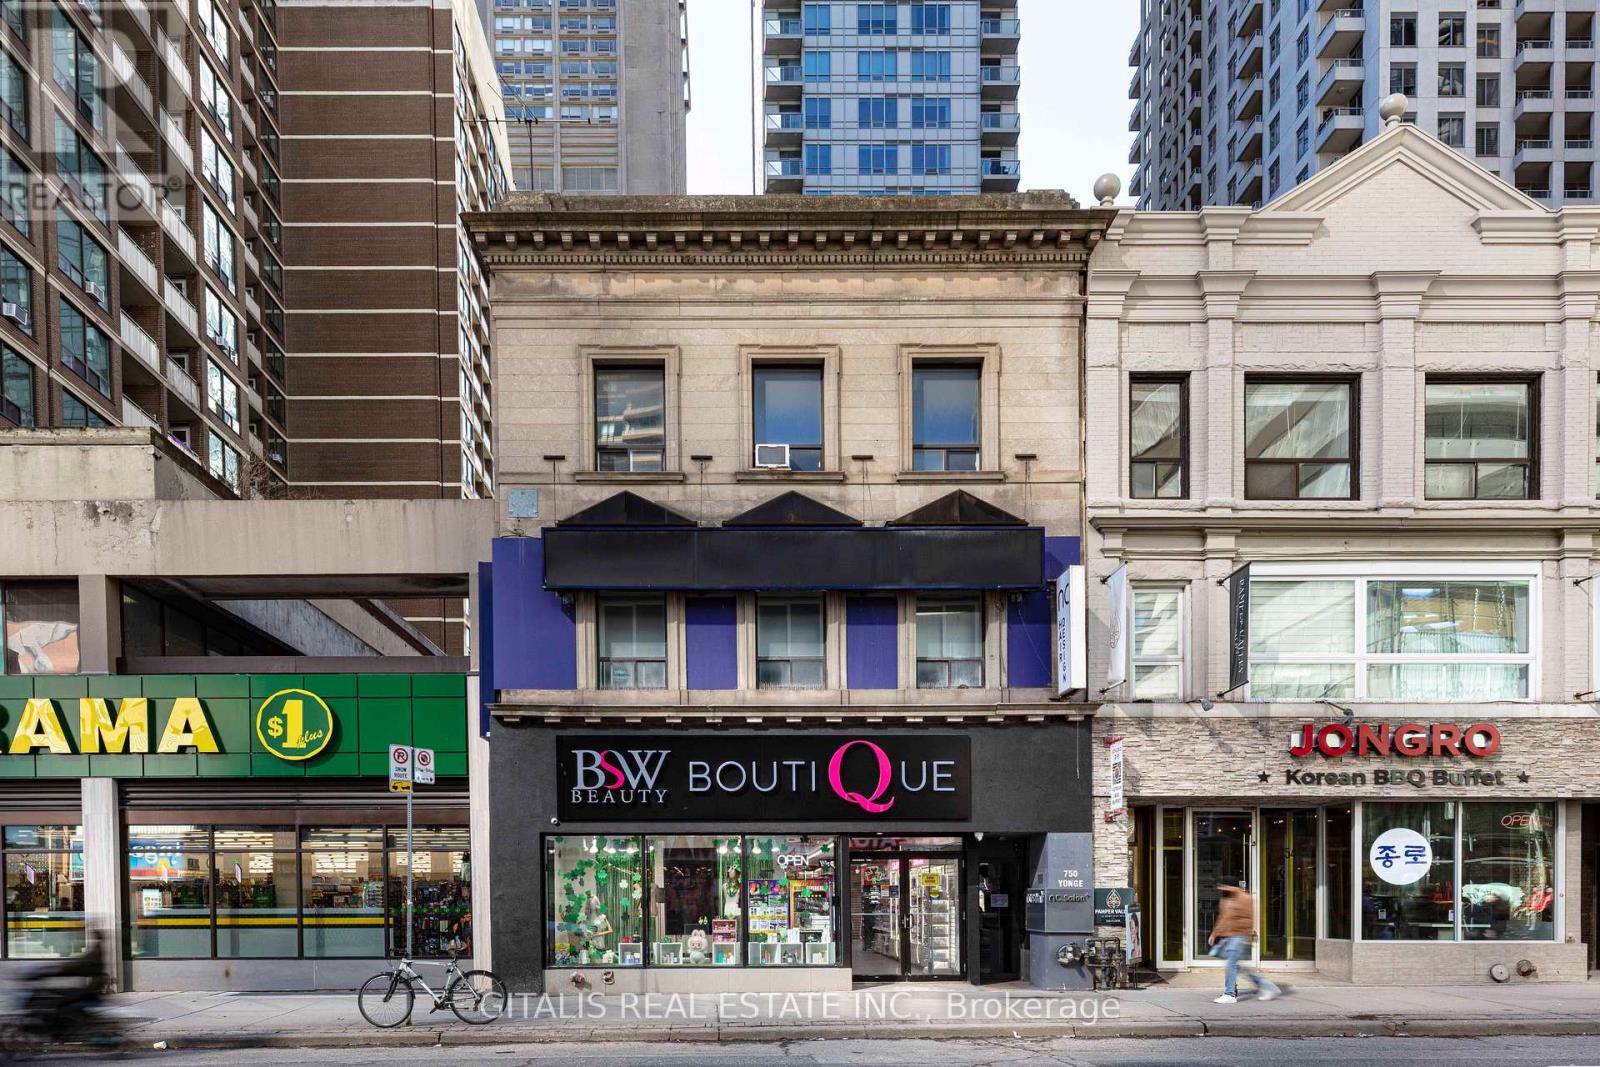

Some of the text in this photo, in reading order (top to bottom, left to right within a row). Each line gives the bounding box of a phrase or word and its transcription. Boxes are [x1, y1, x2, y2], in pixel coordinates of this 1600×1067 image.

[0, 698, 219, 753] AMA
[1288, 723, 1501, 757] JONGRO
[571, 750, 672, 790] BSW
[688, 740, 956, 813] BOUTIQUE
[1286, 768, 1504, 788] Korean BBQ Buffet
[571, 789, 669, 803] BEAUTY
[1501, 815, 1539, 826] OPEN
[777, 854, 809, 866] OPEN
[1375, 845, 1428, 868] 종로
[1058, 880, 1084, 888] YONGE
[1063, 870, 1078, 878] 750
